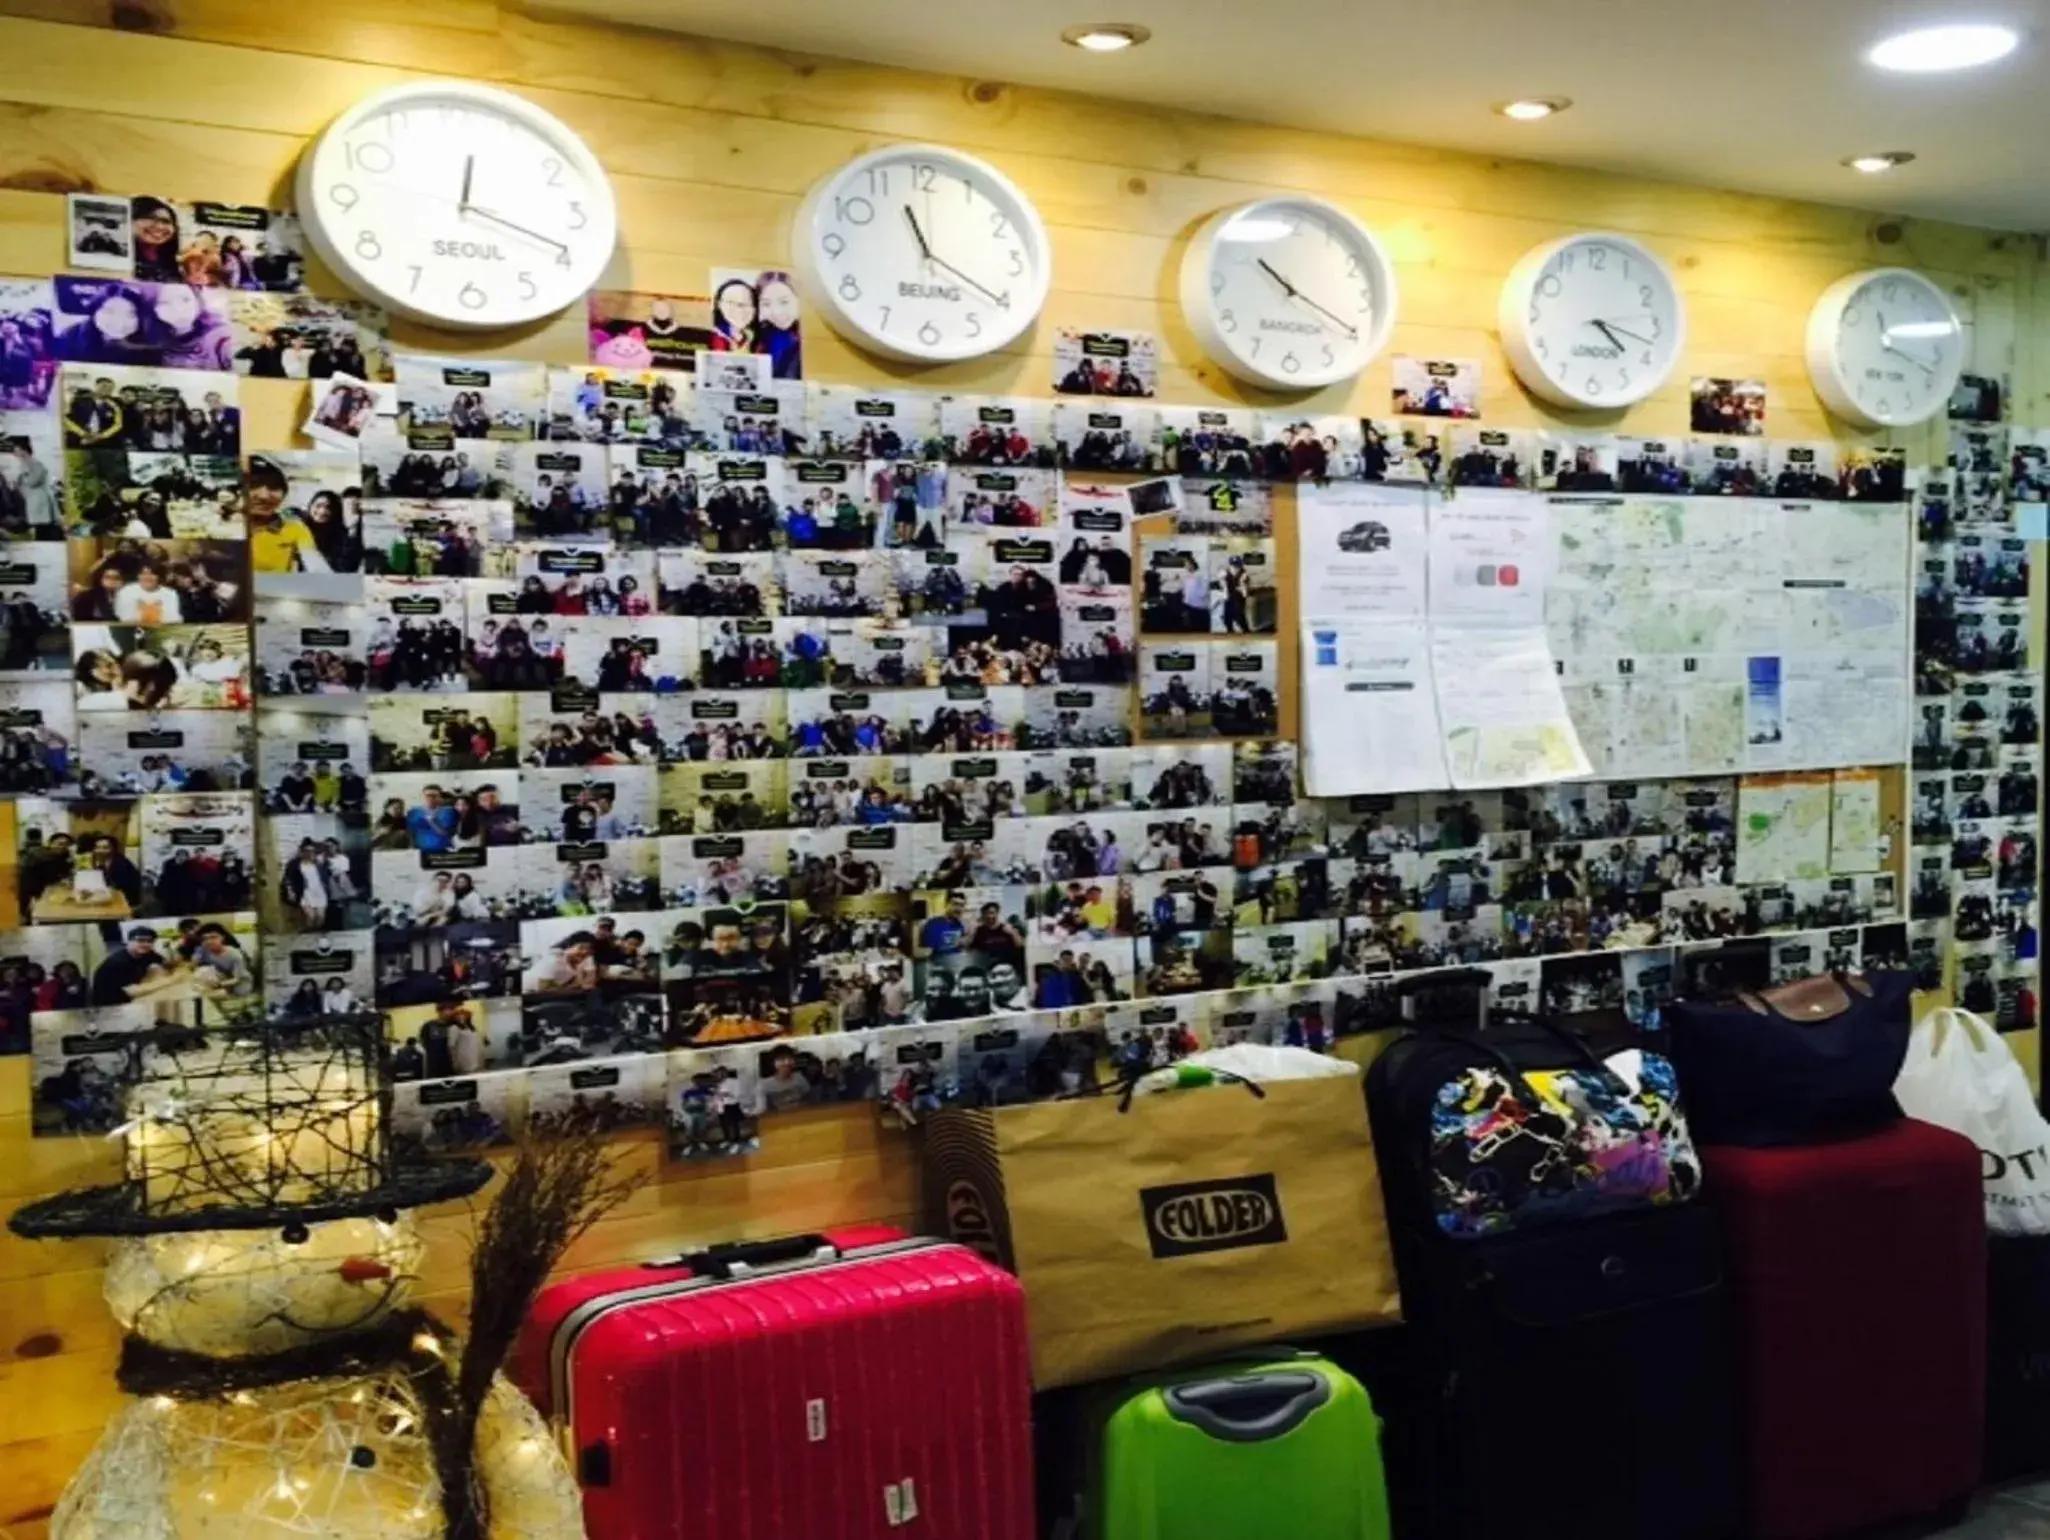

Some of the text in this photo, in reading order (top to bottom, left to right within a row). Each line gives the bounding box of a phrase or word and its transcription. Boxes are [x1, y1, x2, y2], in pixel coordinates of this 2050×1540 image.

[344, 141, 395, 174] 10
[541, 156, 565, 188] 2
[866, 169, 889, 197] 11
[911, 164, 938, 194] 12
[329, 183, 360, 215] 9
[834, 196, 875, 226] 10
[567, 200, 589, 231] 3
[990, 211, 1008, 239] 2
[354, 230, 382, 261] 8
[431, 239, 506, 262] SEOUL
[822, 232, 846, 260] 9
[1007, 250, 1025, 277] 3
[406, 264, 425, 295] 7
[517, 270, 538, 302] 5
[838, 274, 862, 302] 8
[898, 281, 962, 302] BEIJING
[457, 280, 489, 311] 6
[879, 305, 892, 332] 7
[965, 312, 982, 338] 5
[917, 320, 943, 347] 6
[1281, 350, 1301, 375] 6
[1157, 1191, 1270, 1240] FOLDER
